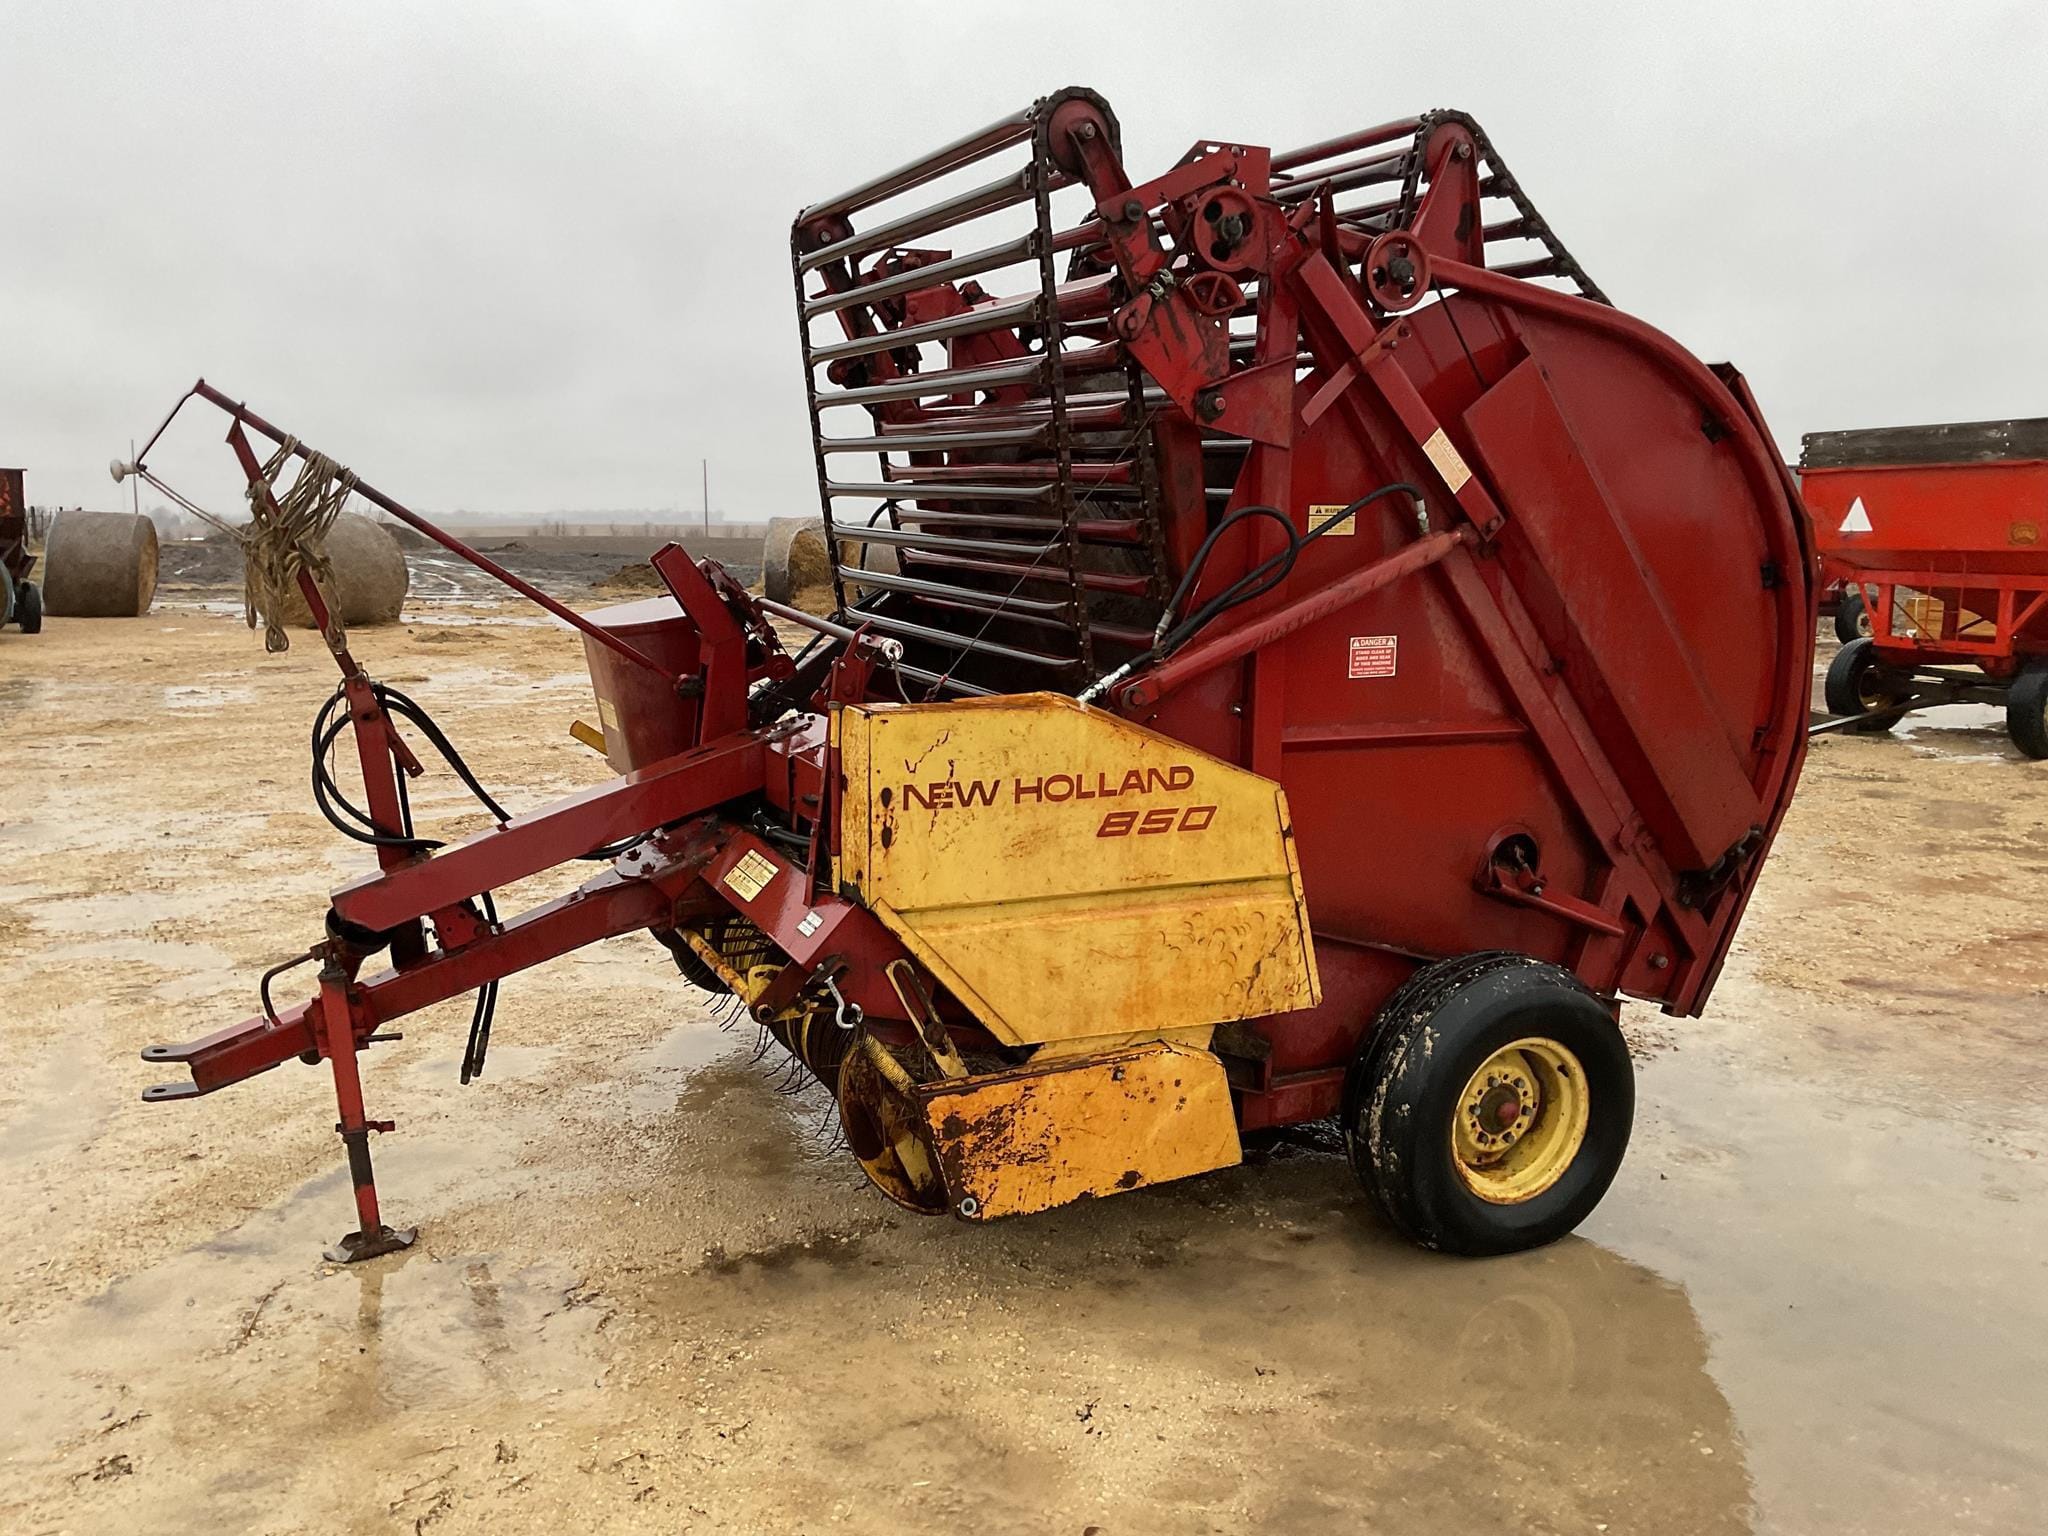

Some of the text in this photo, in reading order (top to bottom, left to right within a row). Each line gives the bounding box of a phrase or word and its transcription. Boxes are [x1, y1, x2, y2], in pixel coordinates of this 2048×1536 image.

[1360, 639, 1387, 647] DANGER
[903, 766, 1194, 811] NEW HOLLAND
[1096, 806, 1217, 837] 850
